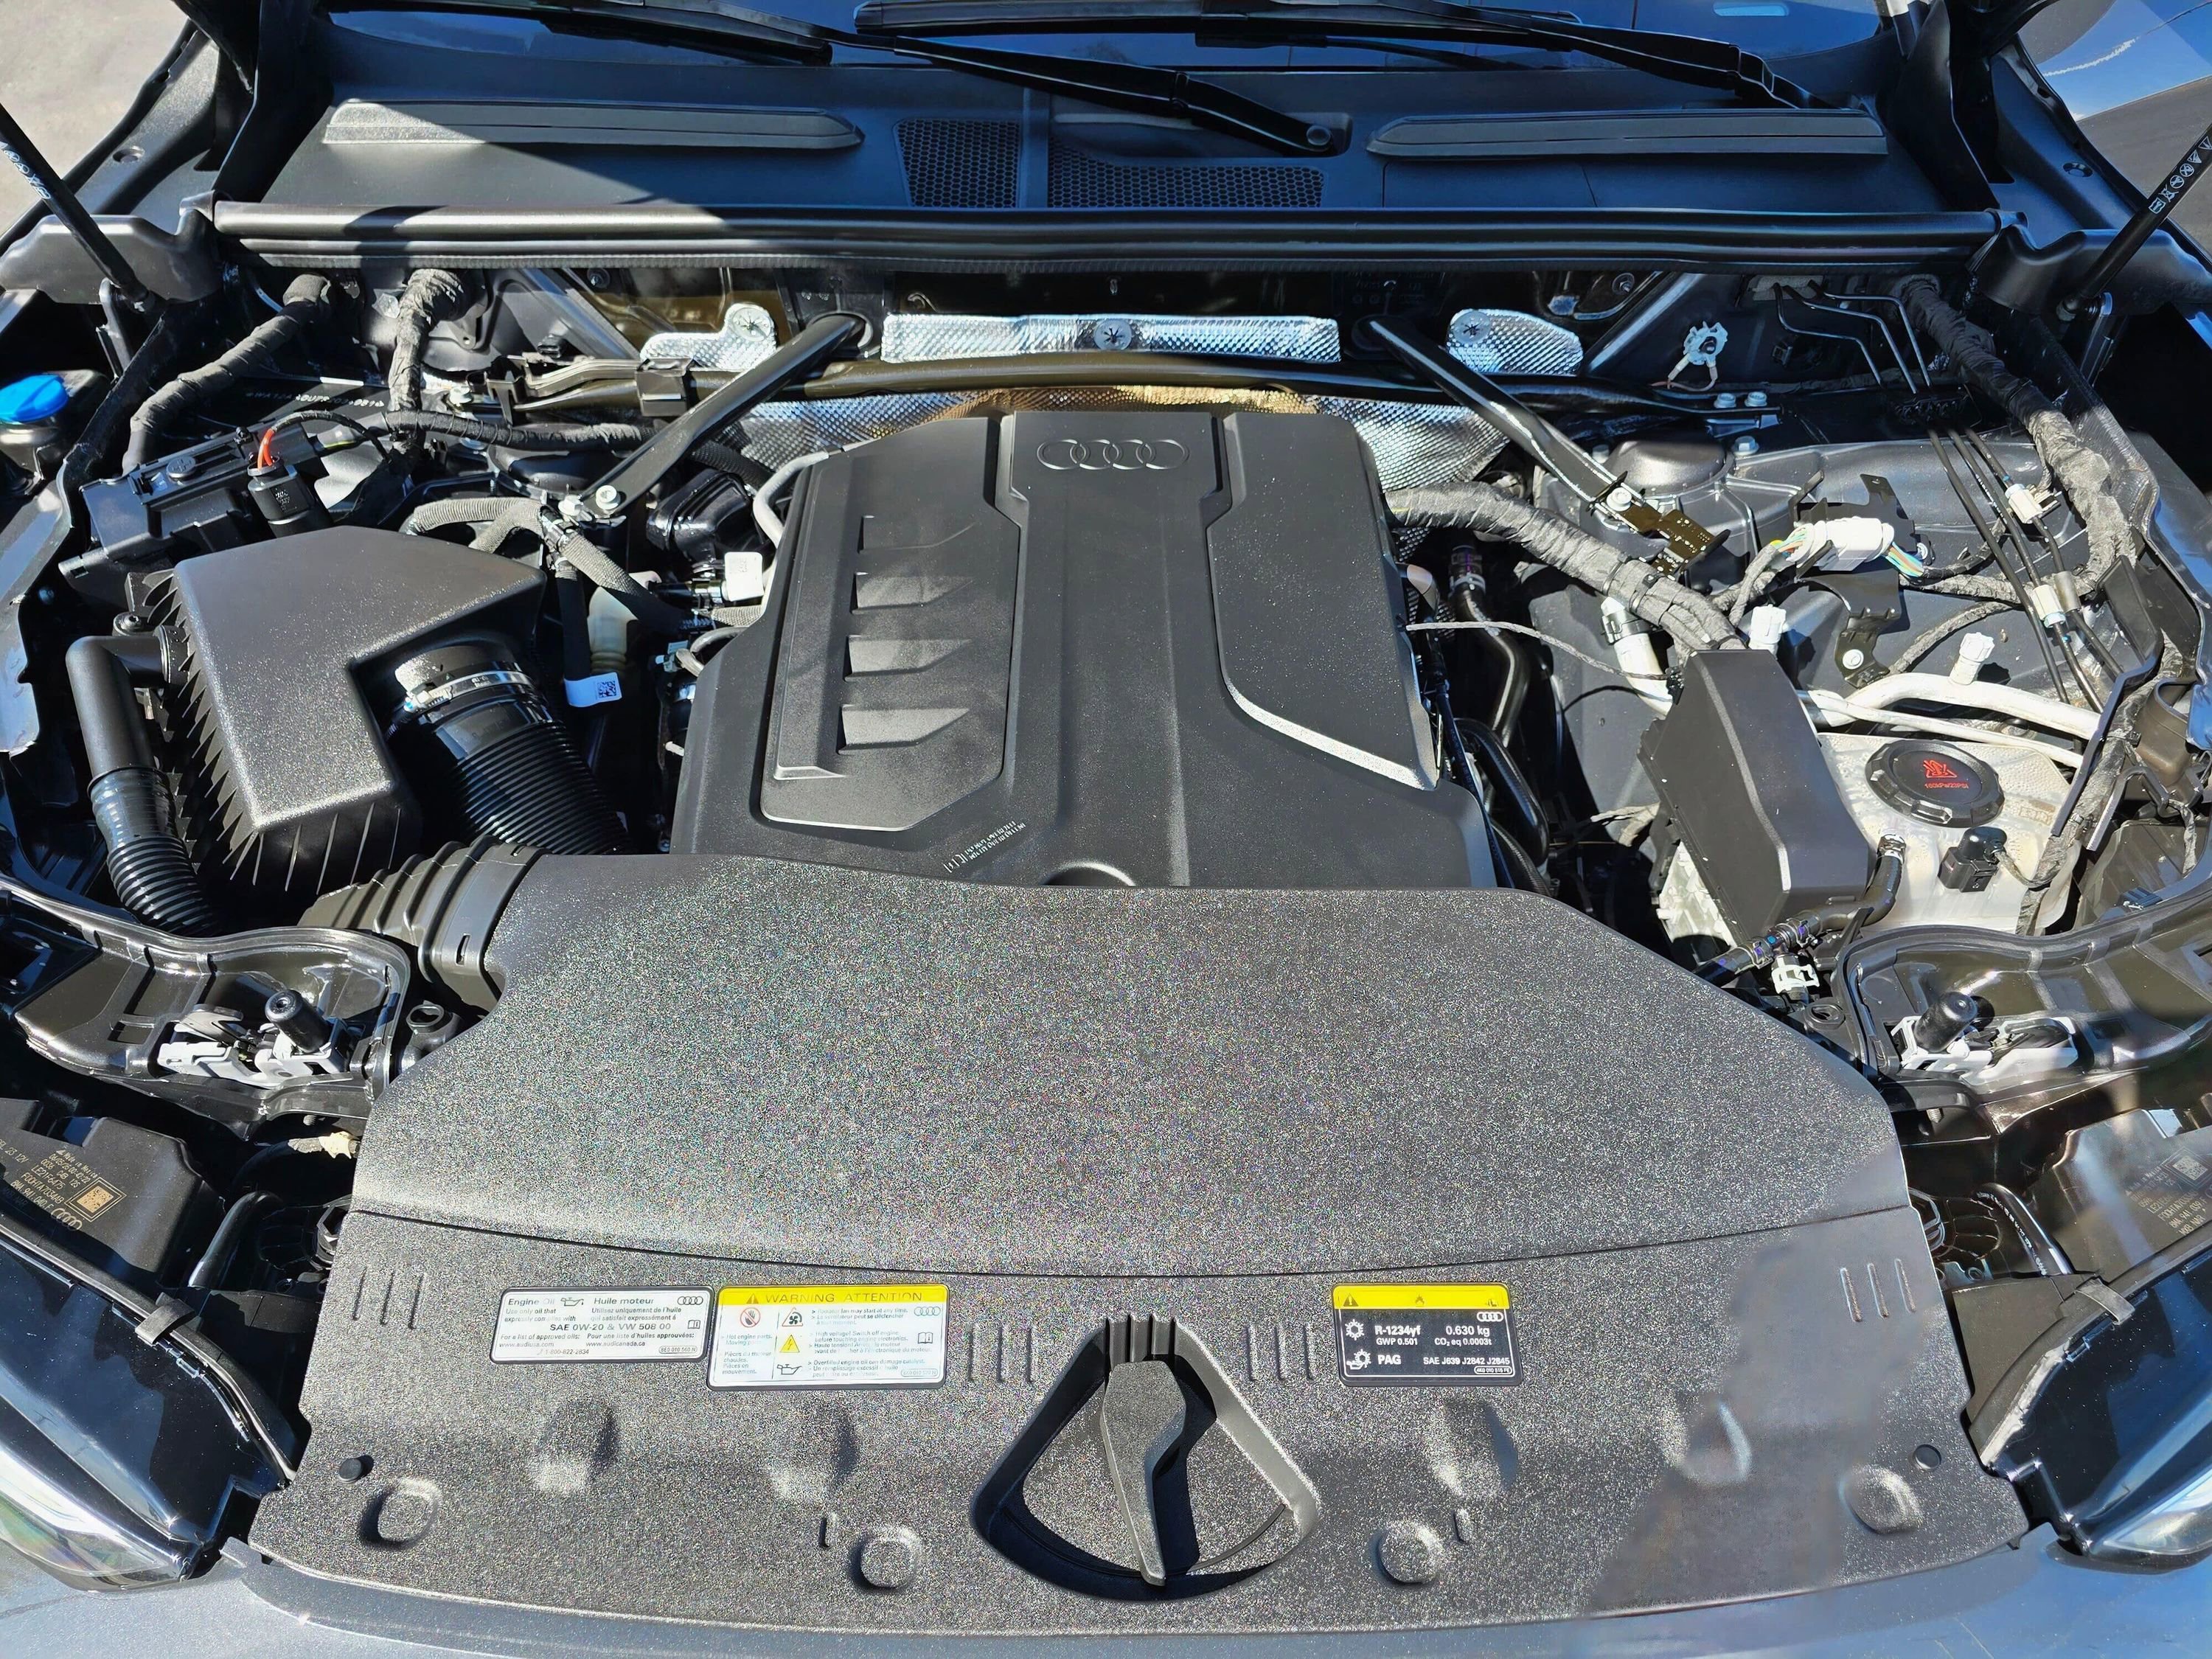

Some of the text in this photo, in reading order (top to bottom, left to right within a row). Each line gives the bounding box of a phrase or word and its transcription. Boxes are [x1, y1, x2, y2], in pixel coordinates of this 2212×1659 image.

[63, 1152, 76, 1163] Made
[81, 1164, 98, 1178] Mexico
[31, 1165, 66, 1190] LE21F6475
[765, 1292, 922, 1303] WARNING ATTENTION
[1374, 1325, 1490, 1337] R-1234yf 0.630 kg
[1463, 1338, 1492, 1346] 0.0003t
[1377, 1354, 1401, 1364] PAG
[1423, 1357, 1440, 1365] SAE
[1441, 1357, 1461, 1365] J639
[1461, 1357, 1485, 1365] J2842
